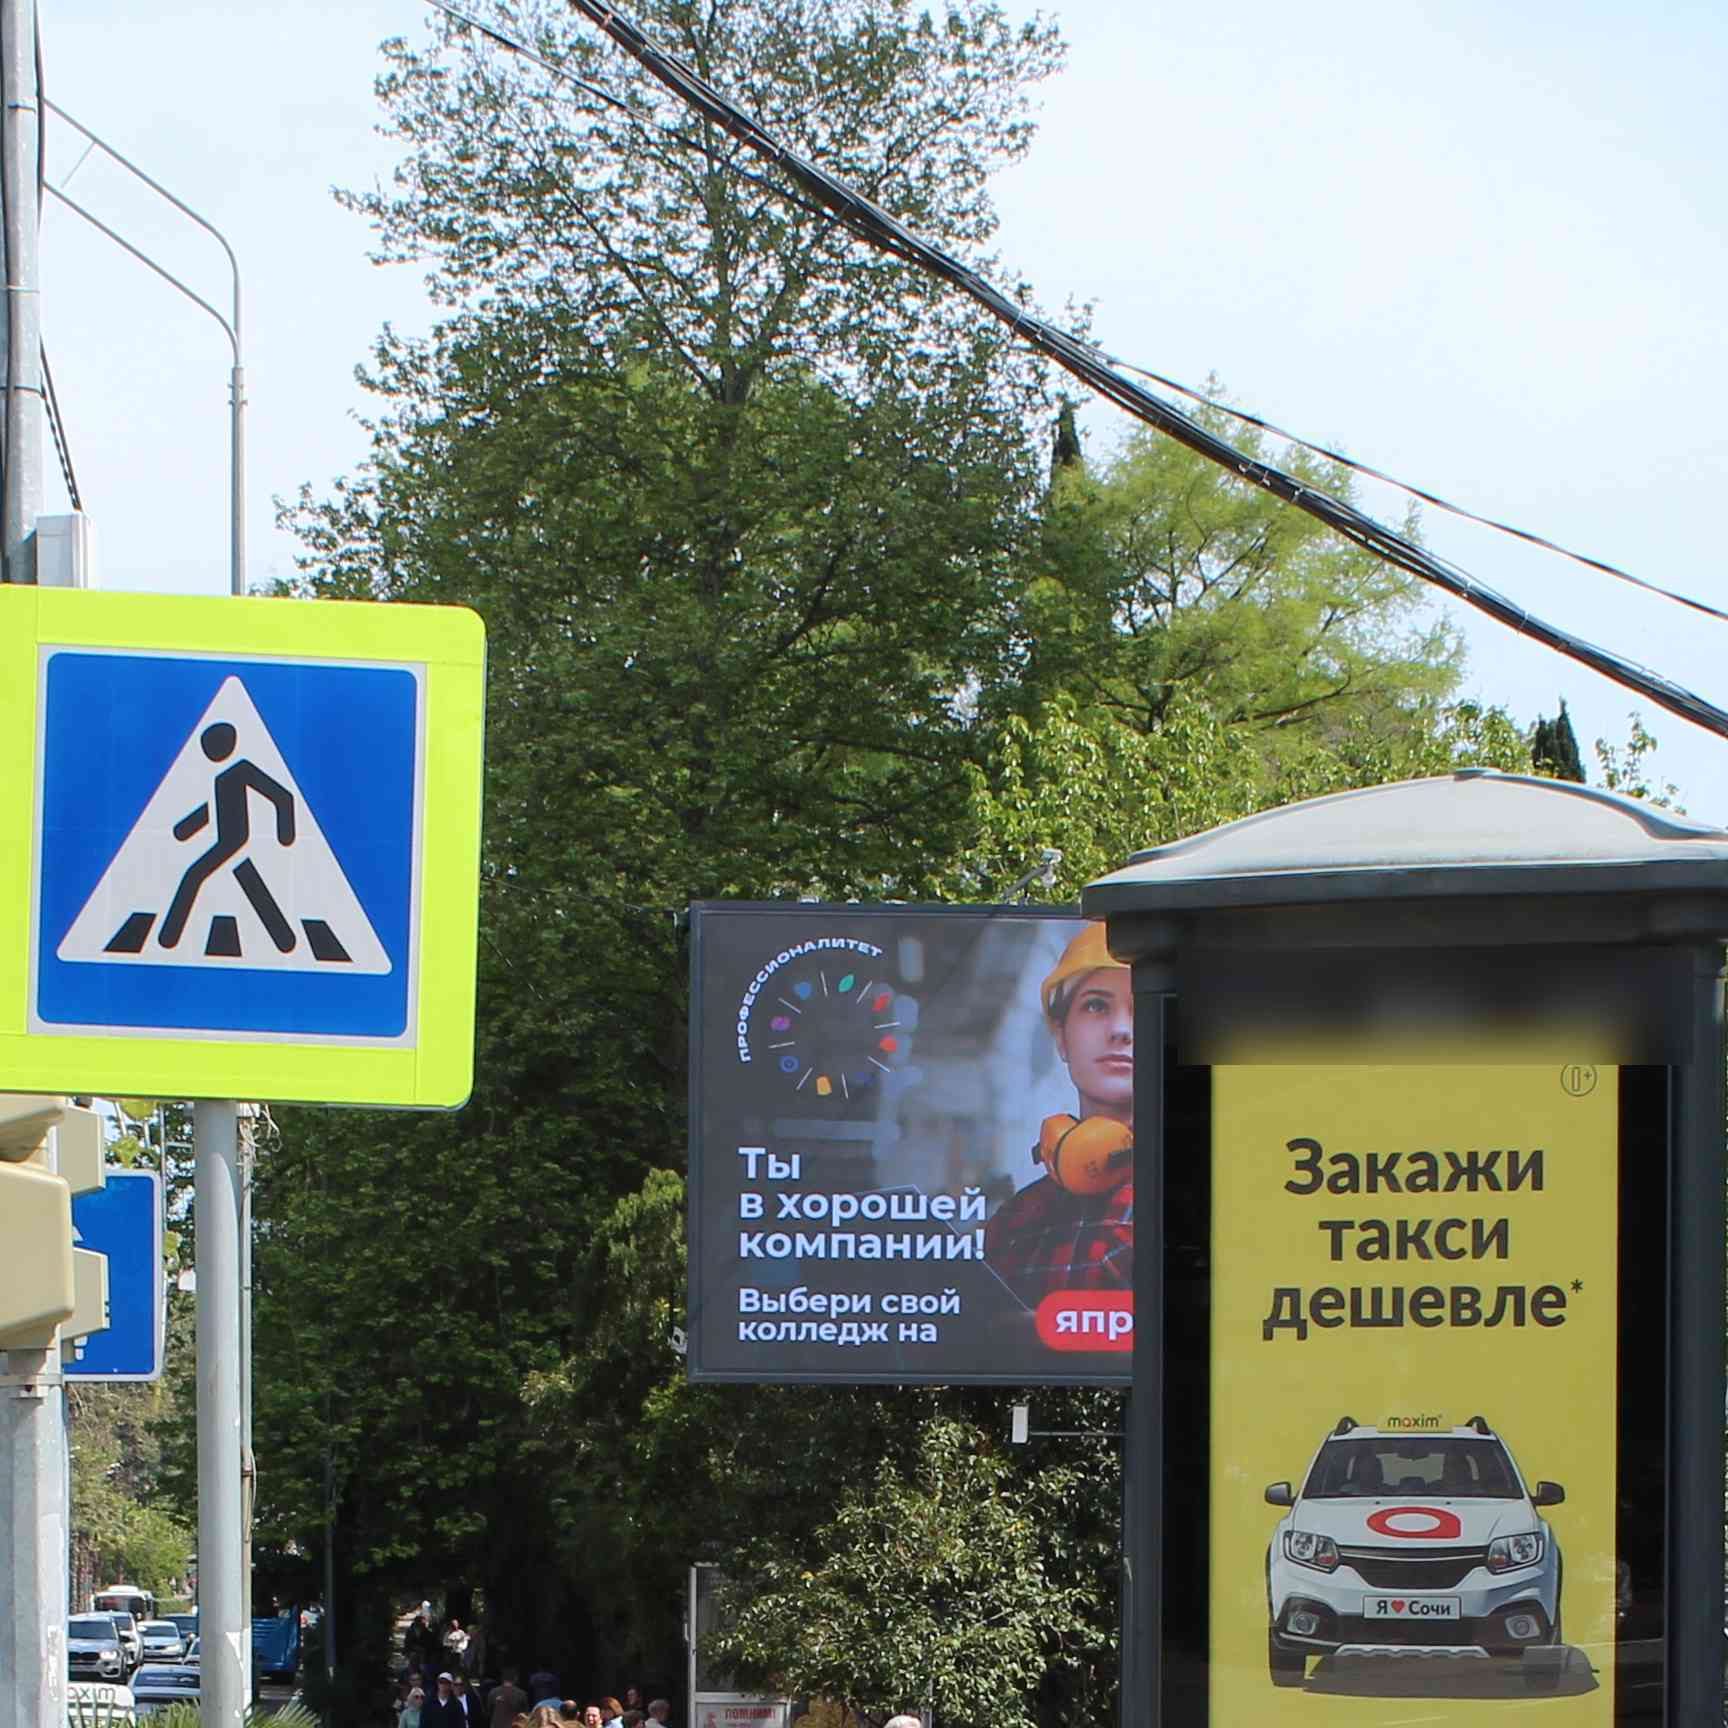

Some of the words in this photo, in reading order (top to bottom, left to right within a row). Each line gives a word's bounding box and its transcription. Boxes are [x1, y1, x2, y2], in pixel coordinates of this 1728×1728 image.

[736, 937, 885, 1063] ПРОФЕССИОНАЛИТЕТ
[738, 1146, 801, 1180] Ты
[1283, 1137, 1545, 1195] Закажи
[740, 1193, 764, 1219] в
[777, 1187, 987, 1227] хорошей
[740, 1229, 986, 1261] компании!
[1318, 1217, 1510, 1262] такси
[739, 1286, 872, 1319] Выбери
[881, 1288, 961, 1314] свой
[738, 1321, 889, 1346] колледж
[898, 1322, 938, 1342] на
[1386, 1414, 1440, 1428] maxim
[1376, 1600, 1388, 1615] Я
[1408, 1601, 1451, 1616] Сочи
